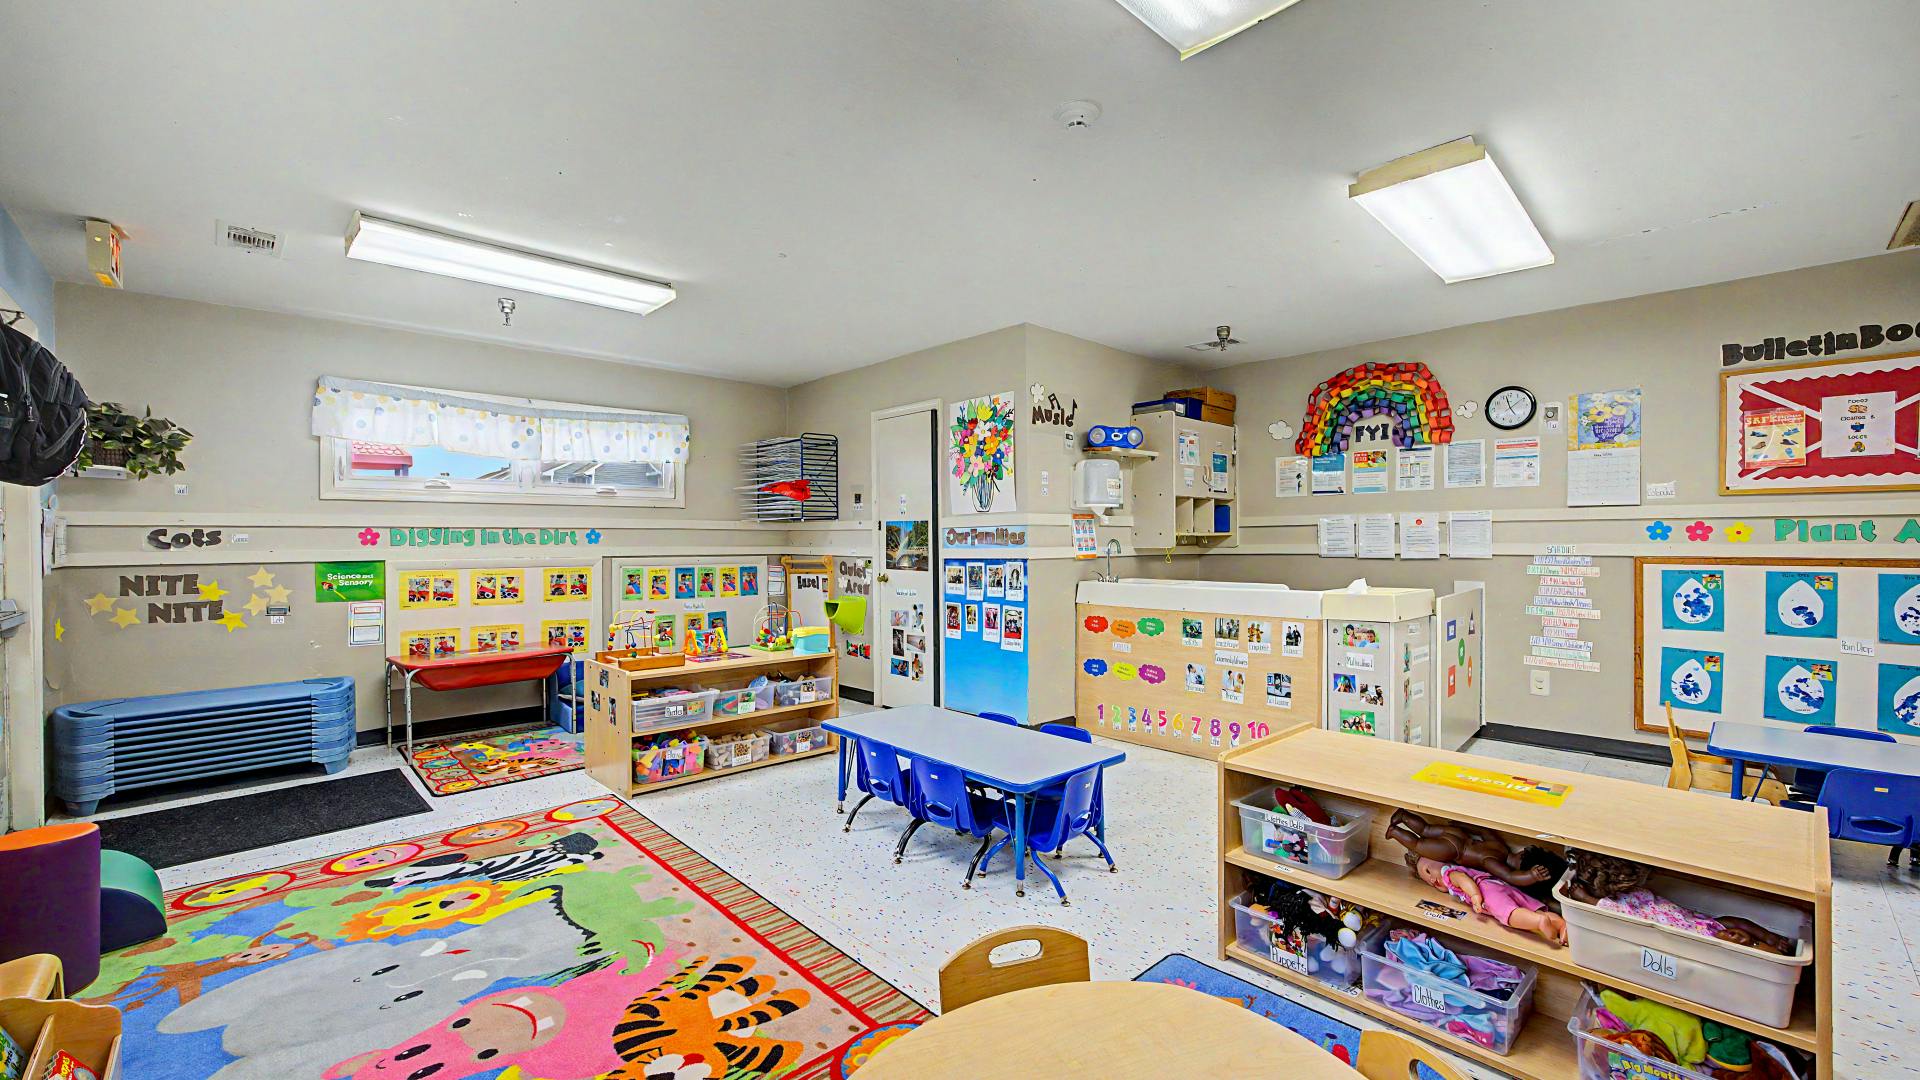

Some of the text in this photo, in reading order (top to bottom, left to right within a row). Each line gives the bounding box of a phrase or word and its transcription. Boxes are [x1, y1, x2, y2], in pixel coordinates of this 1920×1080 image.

[1721, 321, 1920, 366] Bulletin Bo
[1032, 406, 1073, 427] Music
[1355, 423, 1390, 443] FYI
[147, 529, 222, 549] Cots
[390, 528, 578, 547] Digging in the Dirt
[946, 528, 1026, 546] Our Families
[1774, 519, 1877, 542] Plant
[119, 574, 200, 597] NITE
[845, 580, 870, 595] Area
[148, 600, 225, 624] NITE
[1098, 704, 1270, 740] 1 2 3 4 5 6 7 8 9 10
[1272, 946, 1307, 973] Puppets
[1642, 949, 1674, 977] Dolls
[1413, 984, 1446, 1011] Clothes
[1622, 1060, 1641, 1073] Big
